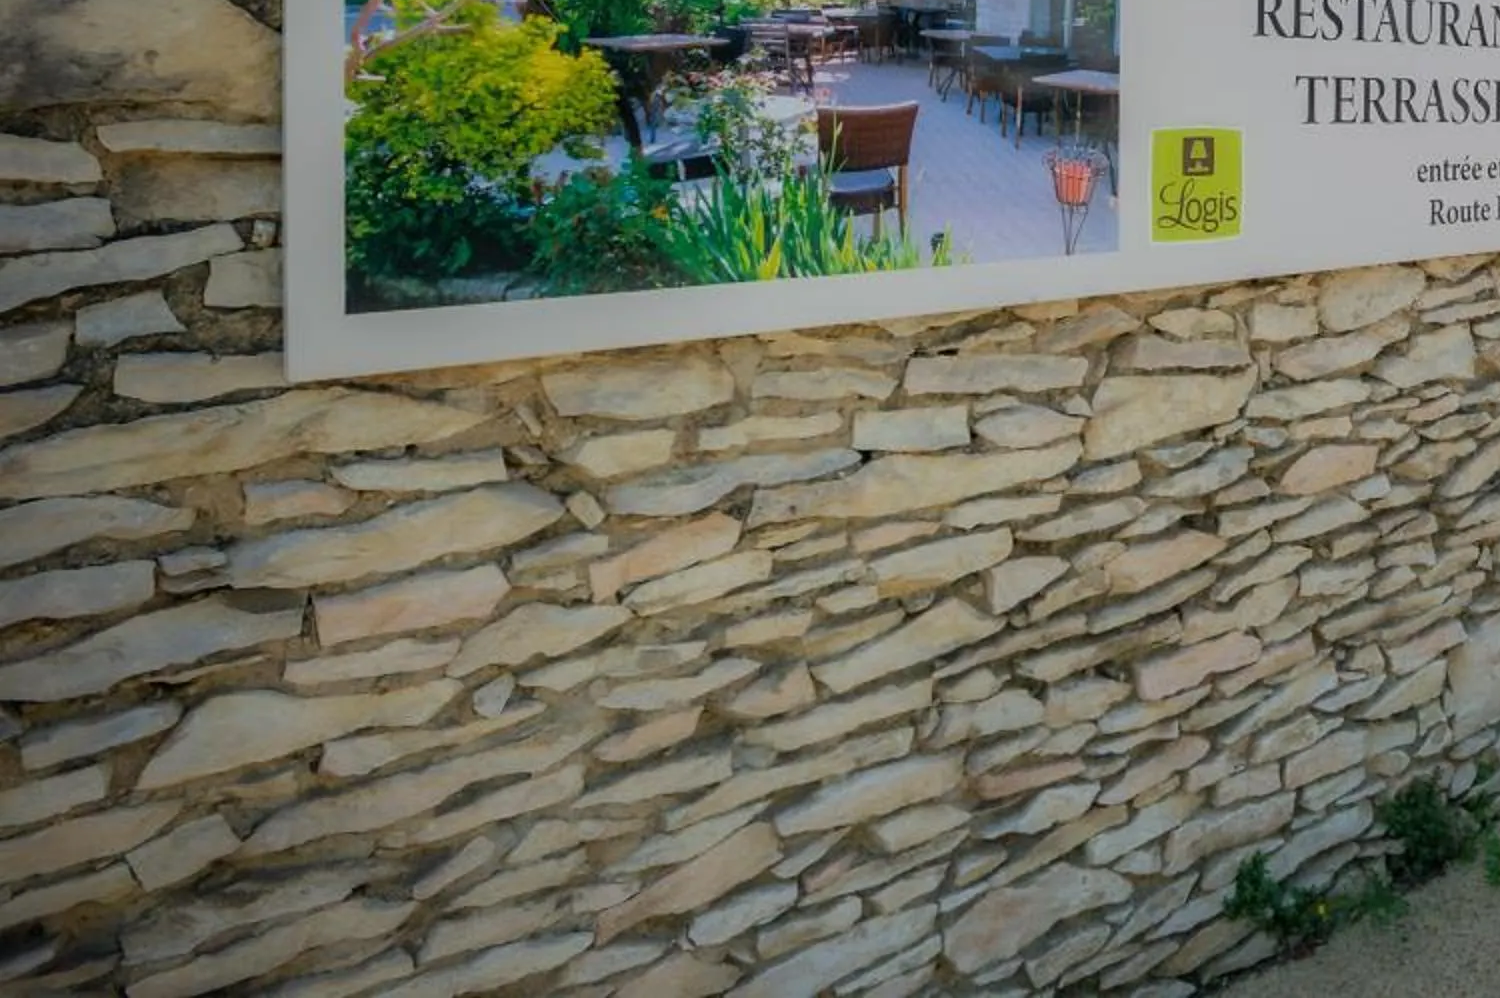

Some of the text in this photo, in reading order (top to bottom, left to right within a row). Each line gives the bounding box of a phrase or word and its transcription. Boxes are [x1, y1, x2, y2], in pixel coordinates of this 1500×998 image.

[1417, 154, 1483, 183] entrée
[1157, 176, 1238, 233] Logis
[1429, 196, 1491, 226] Route
